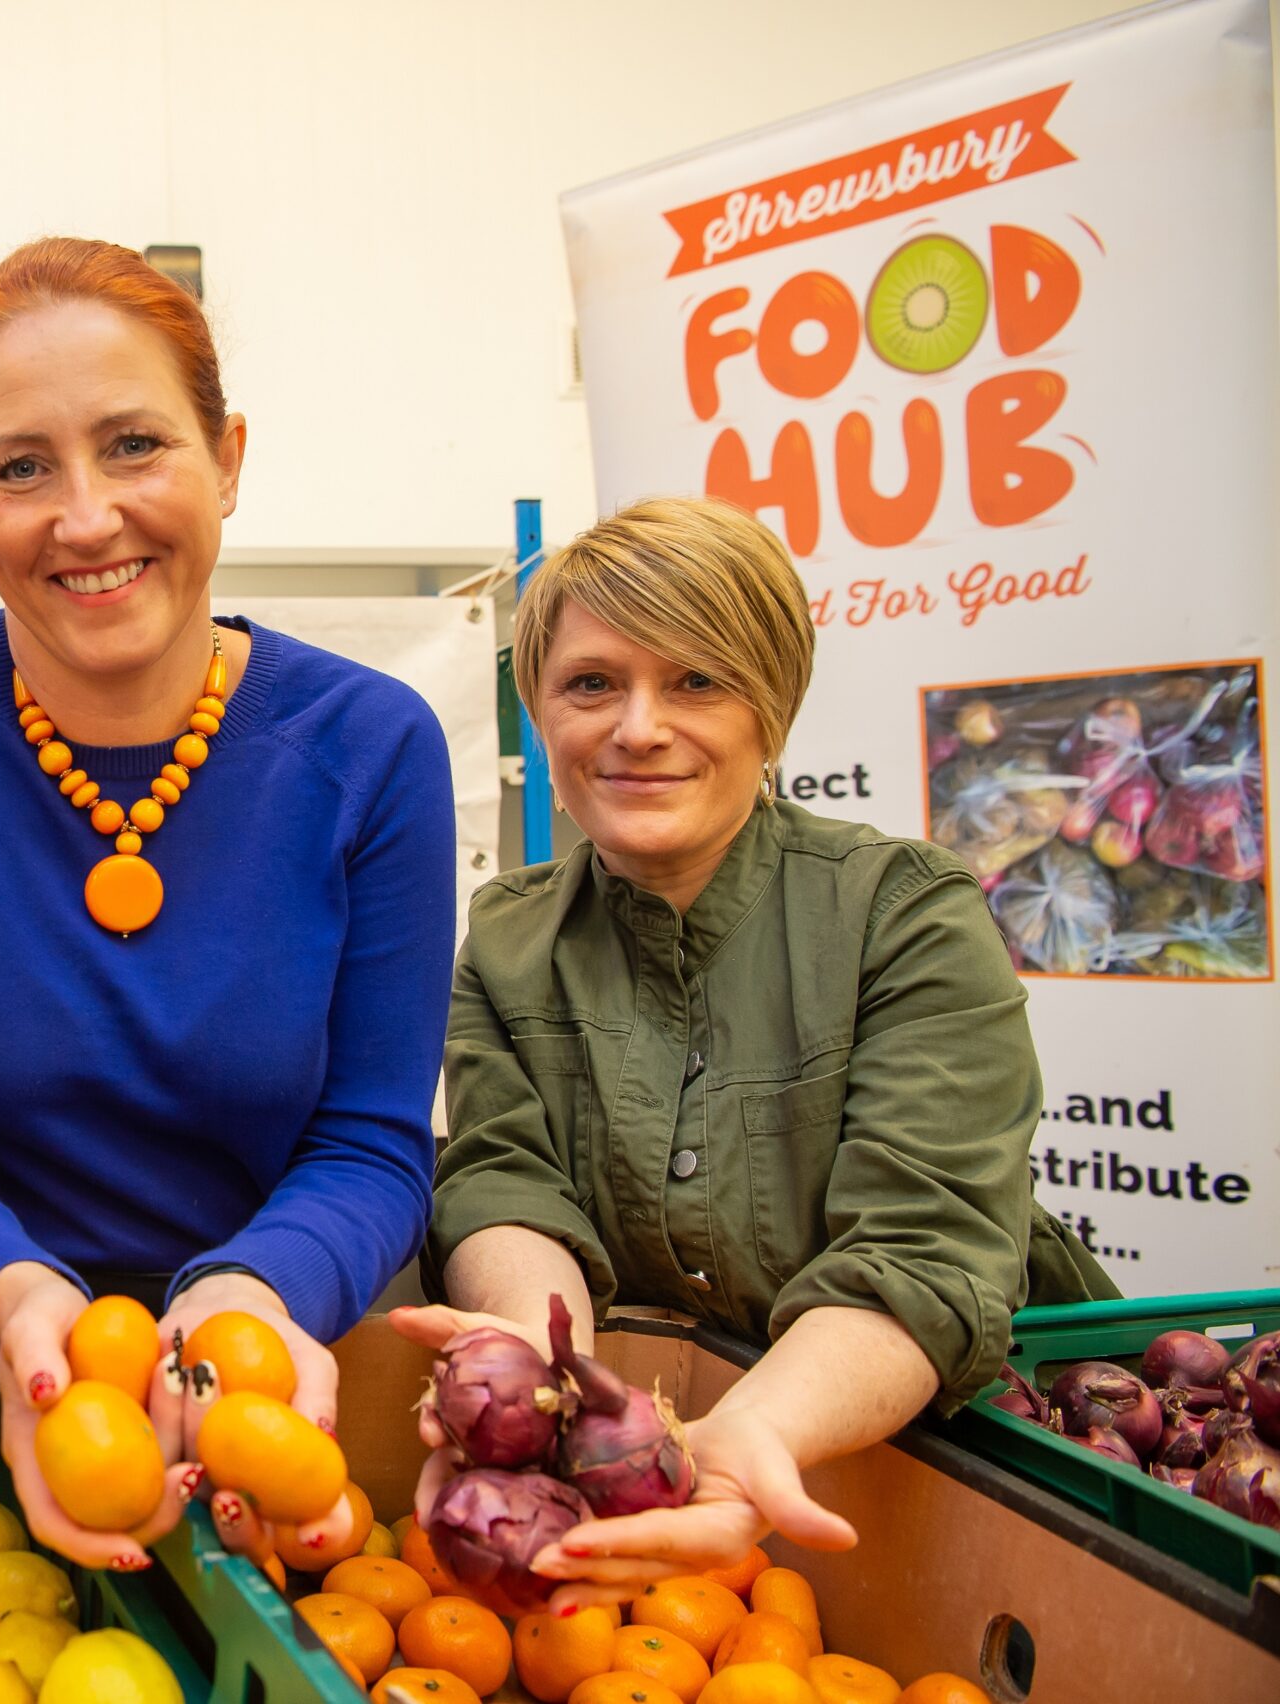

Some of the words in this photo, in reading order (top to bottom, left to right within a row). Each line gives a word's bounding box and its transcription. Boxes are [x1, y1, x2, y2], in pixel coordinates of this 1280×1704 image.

[703, 120, 1031, 265] Shrewsbury
[684, 223, 1082, 421] FOOD
[704, 369, 1076, 558] HUB
[846, 578, 938, 627] For
[947, 553, 1091, 627] Good
